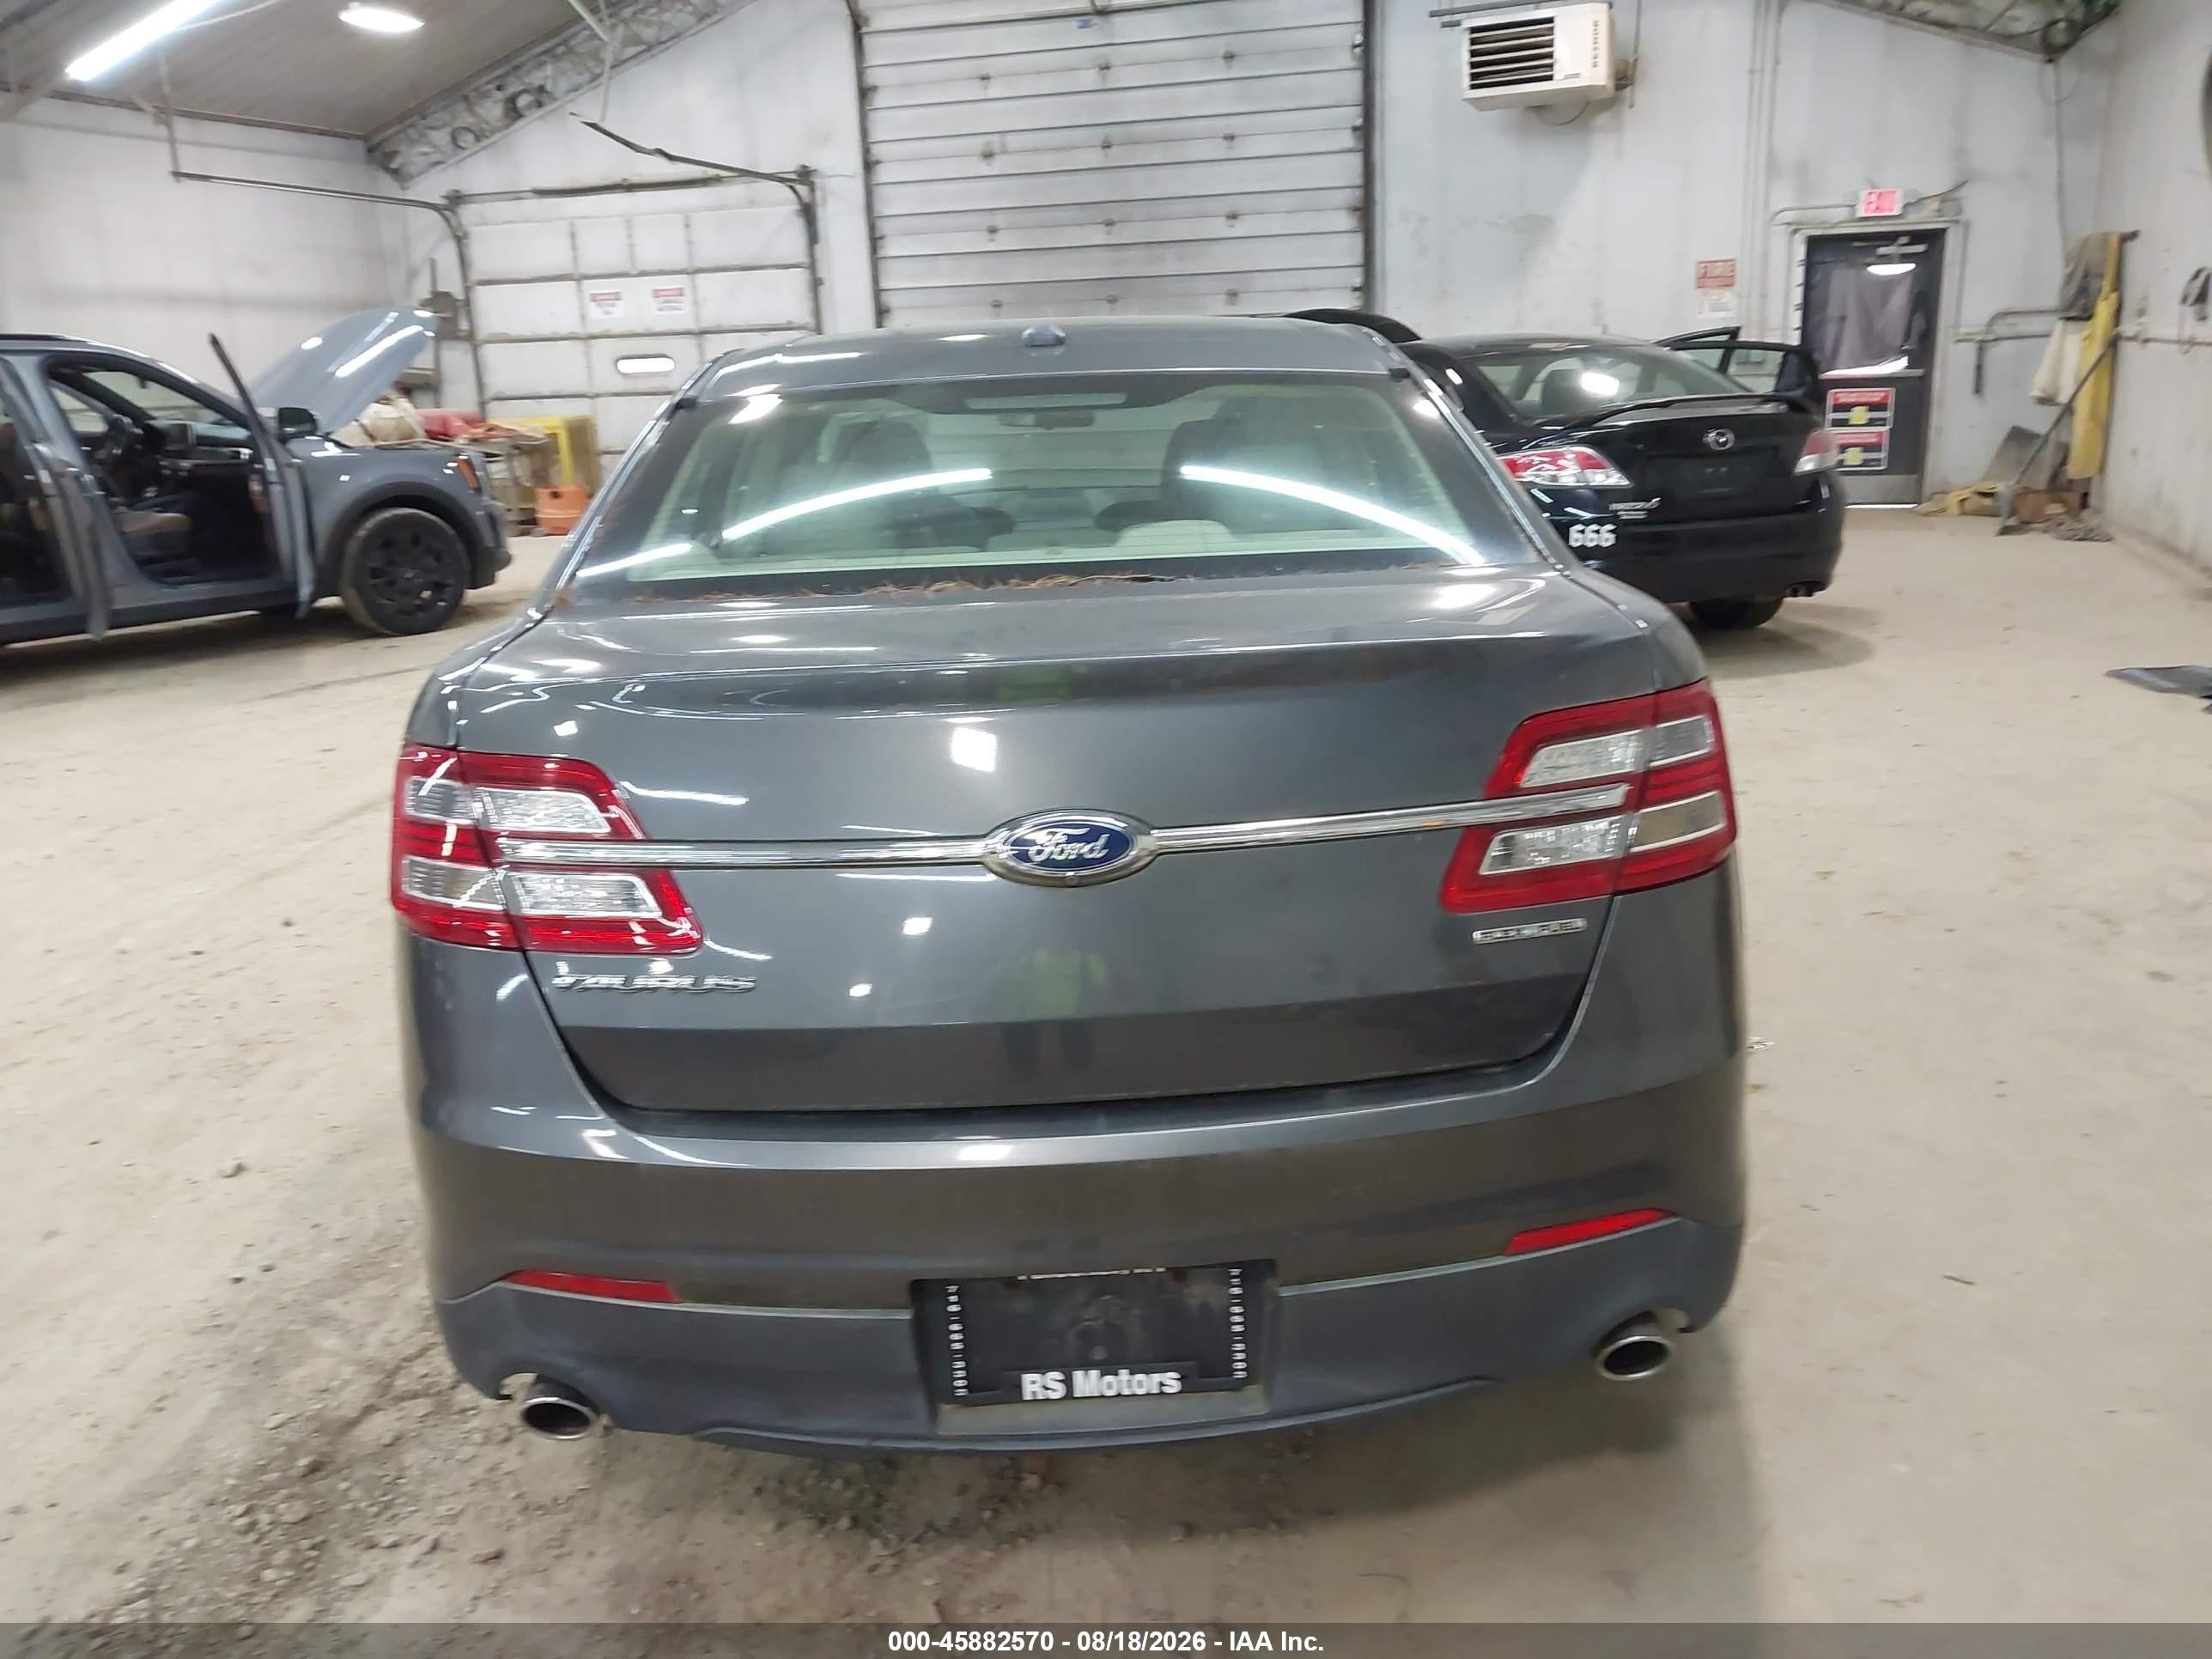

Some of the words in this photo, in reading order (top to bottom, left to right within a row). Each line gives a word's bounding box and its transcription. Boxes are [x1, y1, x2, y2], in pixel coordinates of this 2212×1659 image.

[1568, 523, 1617, 548] 666
[1024, 827, 1111, 863] Ford
[551, 975, 757, 994] TAURUS
[1020, 1370, 1067, 1401] RS
[1072, 1369, 1182, 1399] Motors
